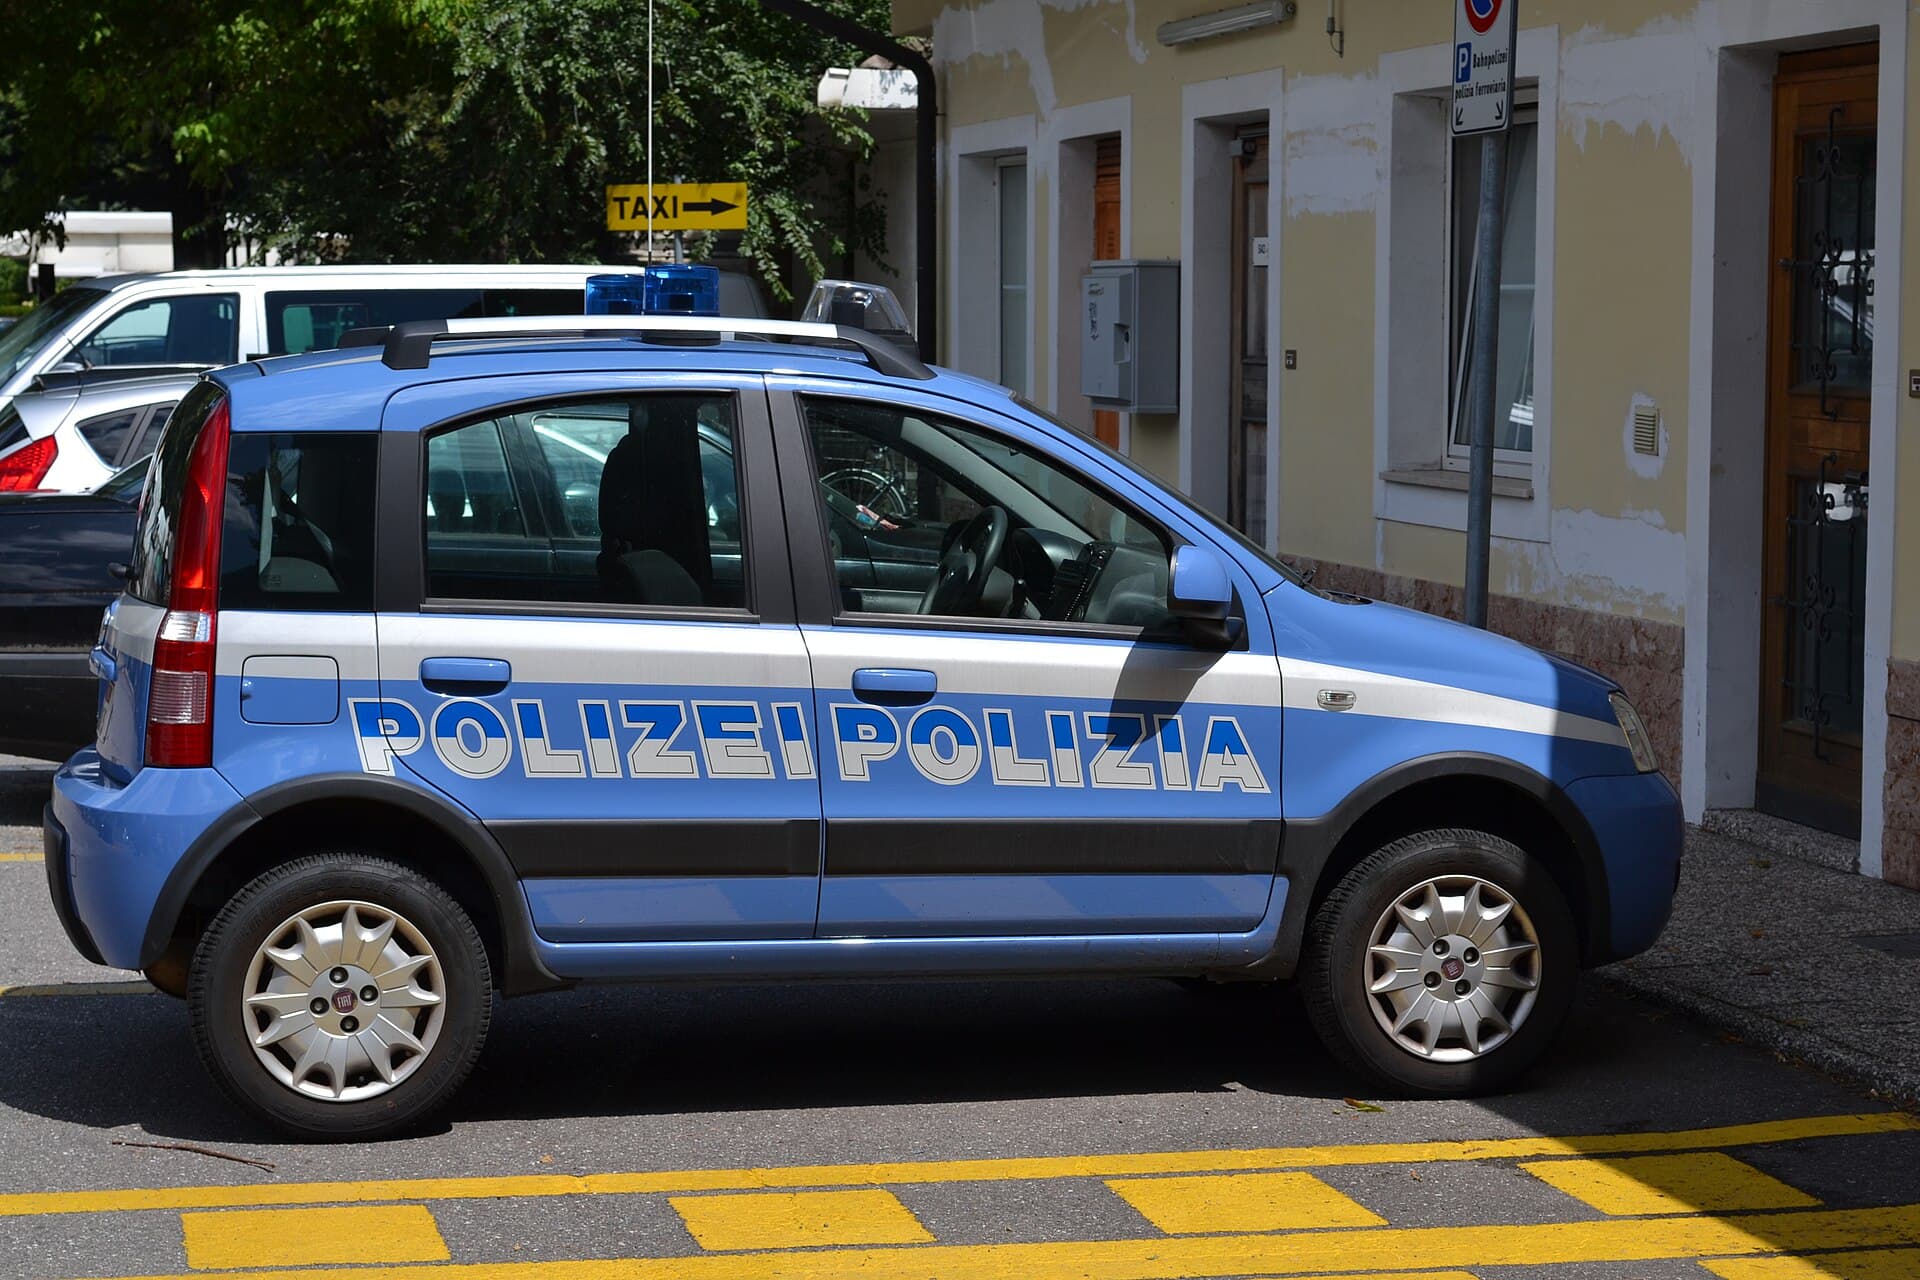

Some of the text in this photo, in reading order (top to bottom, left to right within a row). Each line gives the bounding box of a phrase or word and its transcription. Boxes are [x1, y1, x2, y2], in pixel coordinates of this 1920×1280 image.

[1458, 47, 1508, 79] P Bahnpolizei
[1455, 78, 1506, 103] polizia ferroviaria
[613, 195, 678, 219] TAXI
[347, 697, 1272, 794] POLIZEI POLIZIA
[336, 993, 352, 1009] FIAT
